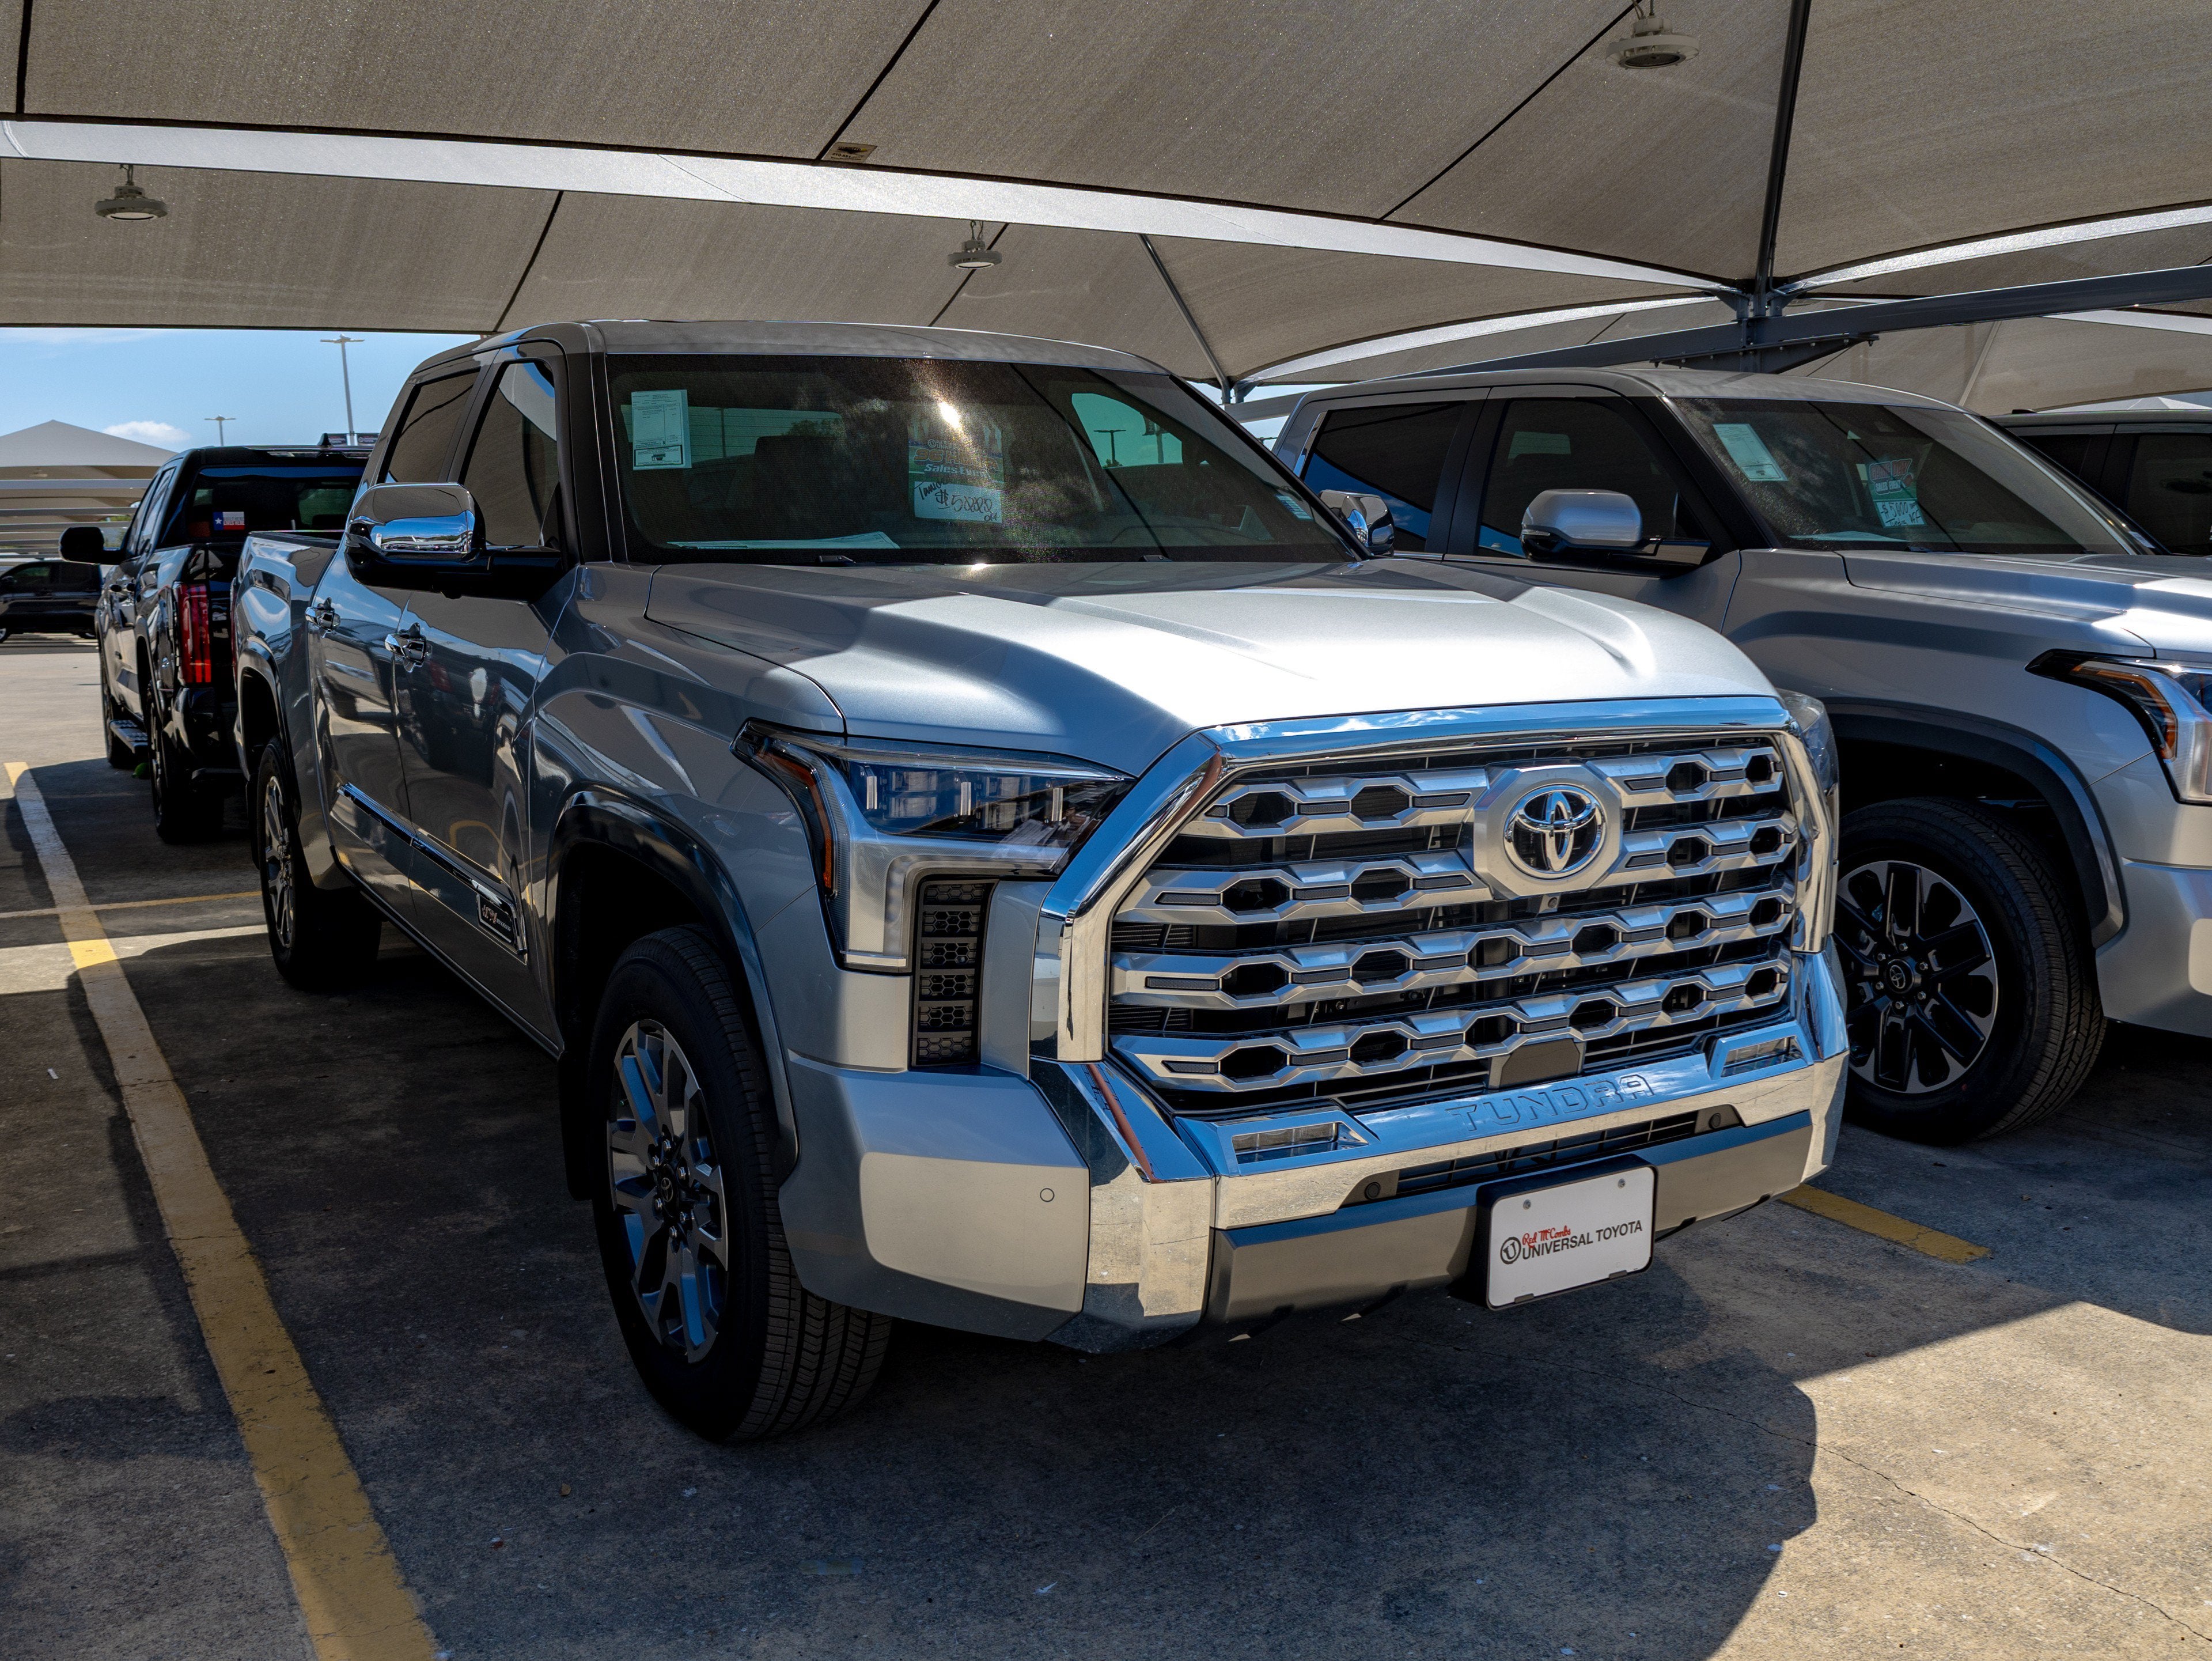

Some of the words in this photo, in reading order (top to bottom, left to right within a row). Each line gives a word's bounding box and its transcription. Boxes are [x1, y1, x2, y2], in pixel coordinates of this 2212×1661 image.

[914, 448, 944, 463] 96
[924, 464, 959, 474] Sales
[1445, 1074, 1655, 1131] TUNDRA
[1522, 1232, 1537, 1248] Red
[1522, 1232, 1594, 1260] UNIVERSAL
[1596, 1220, 1643, 1242] TOYOTA
